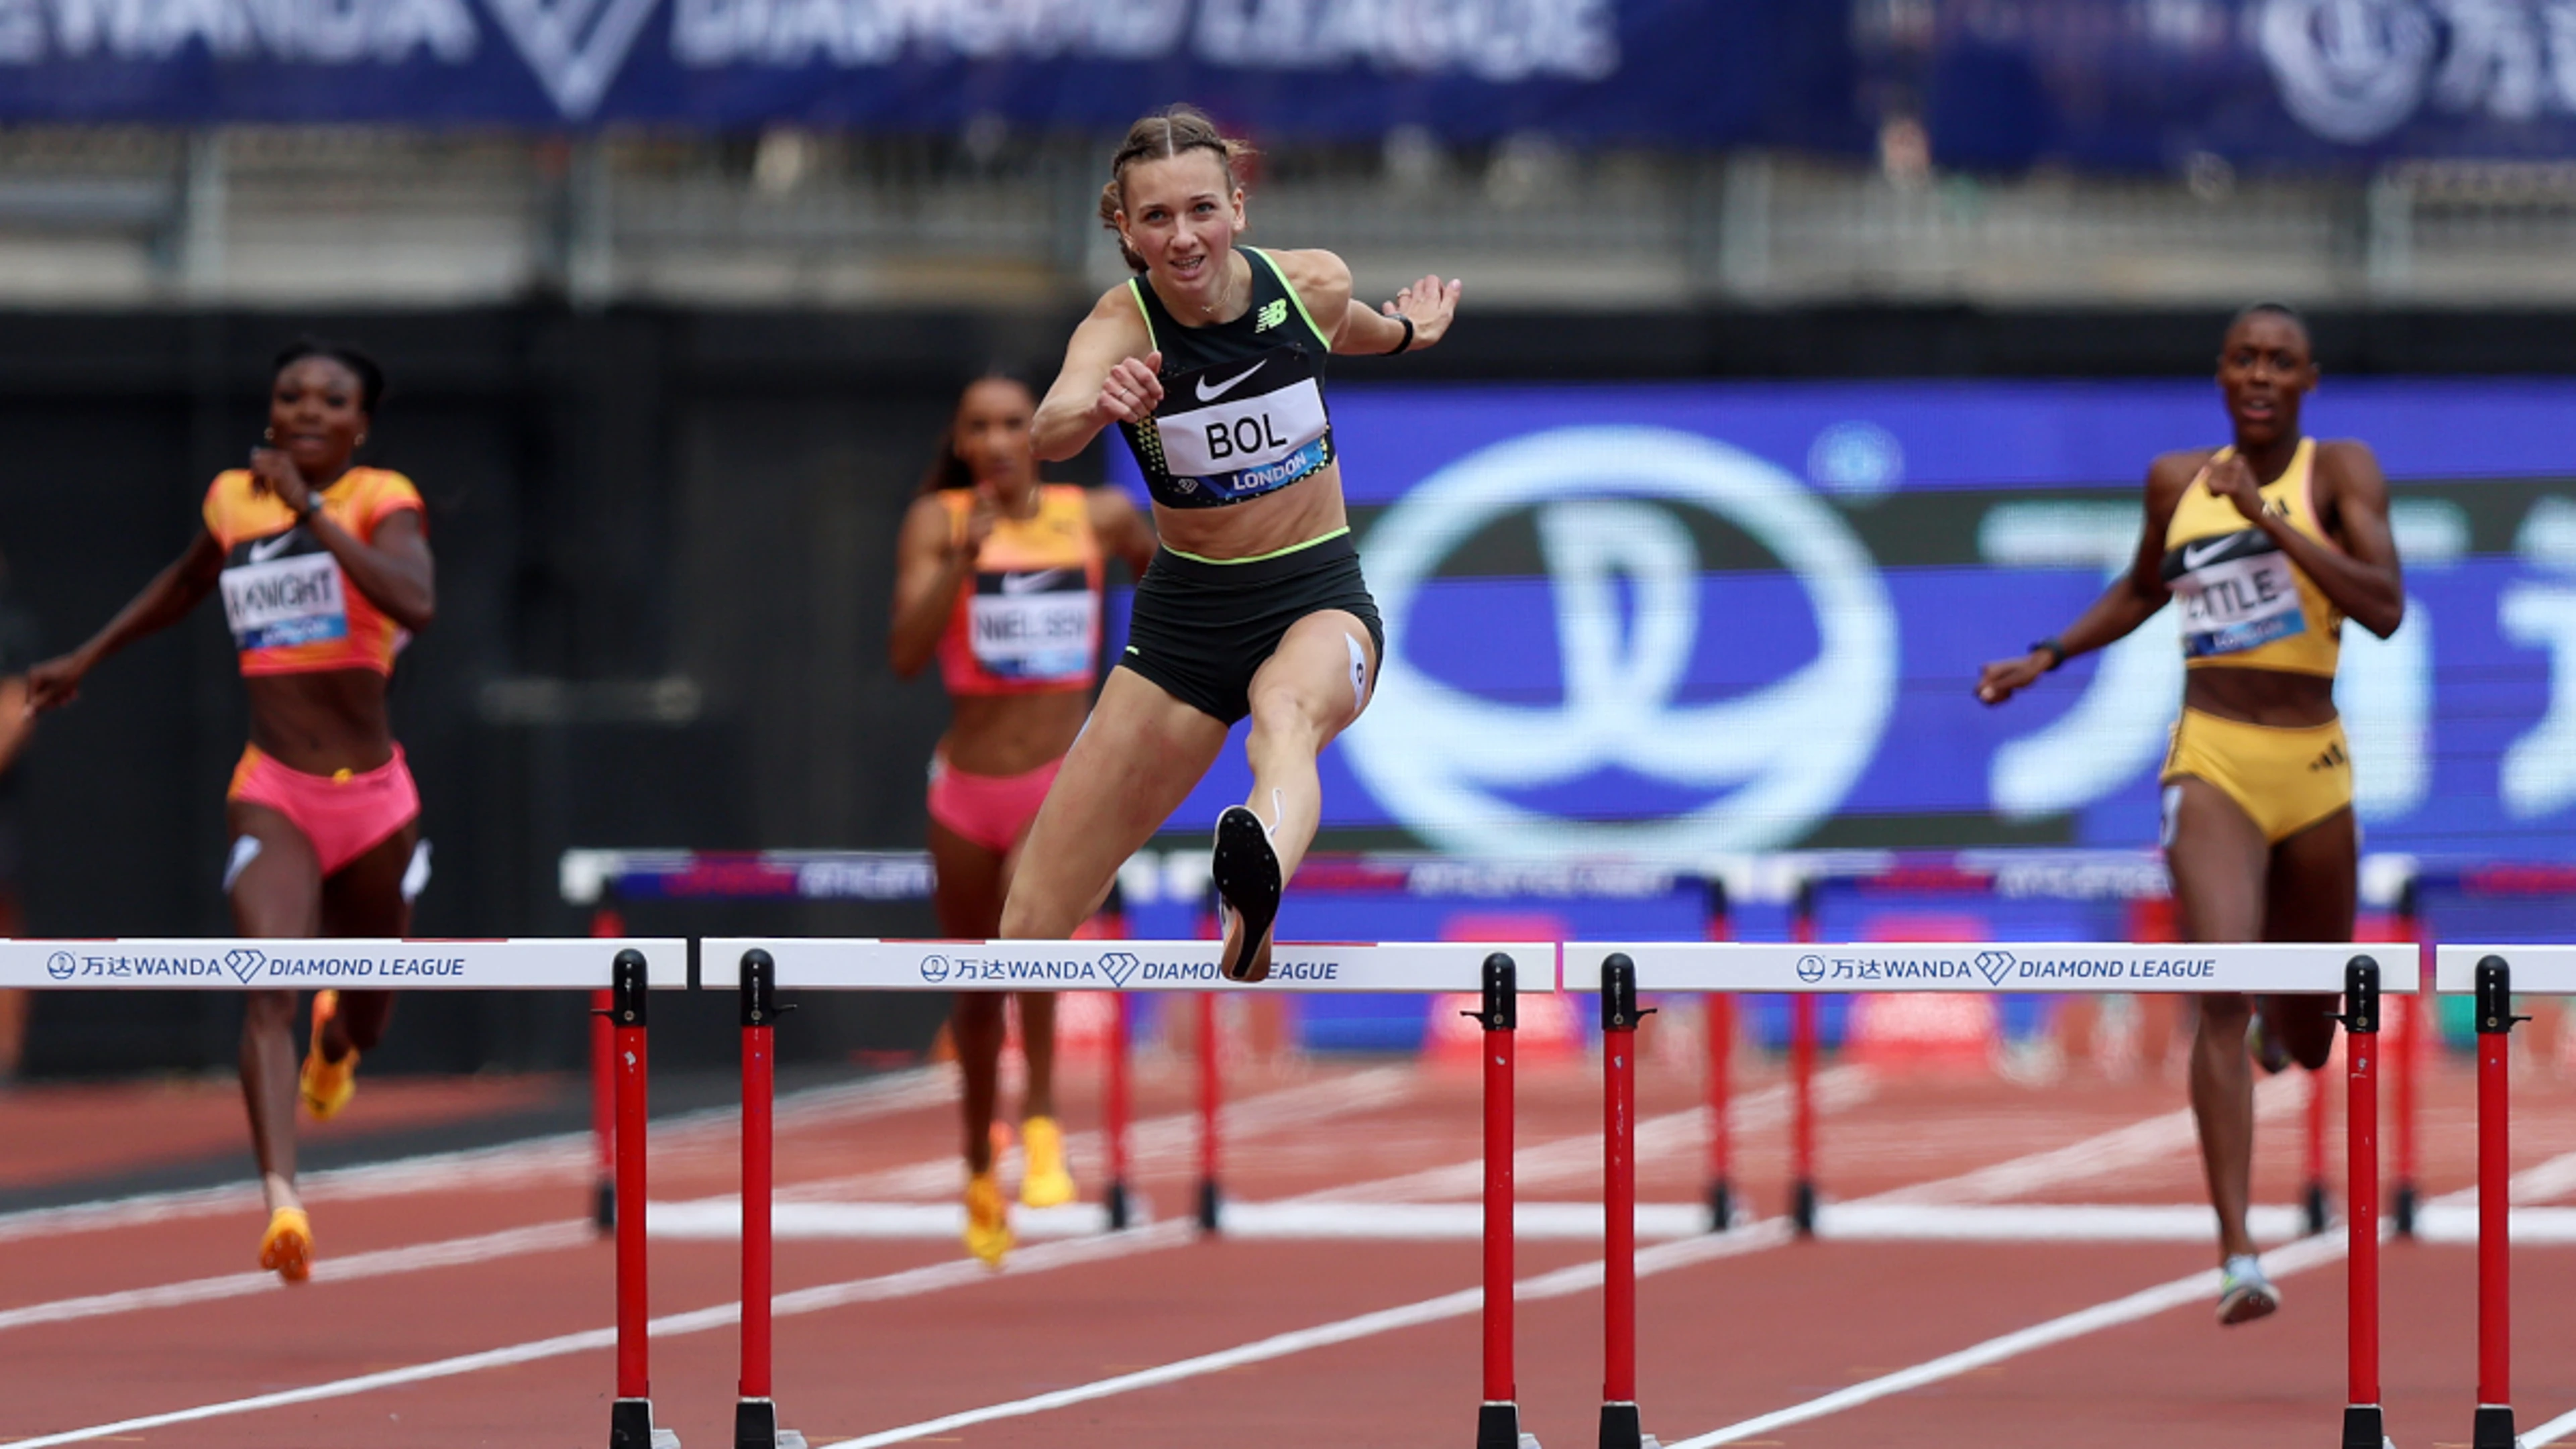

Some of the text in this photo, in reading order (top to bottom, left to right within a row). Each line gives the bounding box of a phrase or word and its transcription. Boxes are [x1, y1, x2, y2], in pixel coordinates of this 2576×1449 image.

[1205, 413, 1287, 460] BOL
[1232, 451, 1307, 490] LONDON
[270, 959, 372, 975] DIAMOND
[379, 959, 465, 975] LEAGUE
[1142, 963, 1222, 979] DIAMO
[1266, 963, 1339, 979] EAGUE
[2019, 961, 2123, 977] DIAMOND
[2130, 960, 2216, 977] LEAGUE
